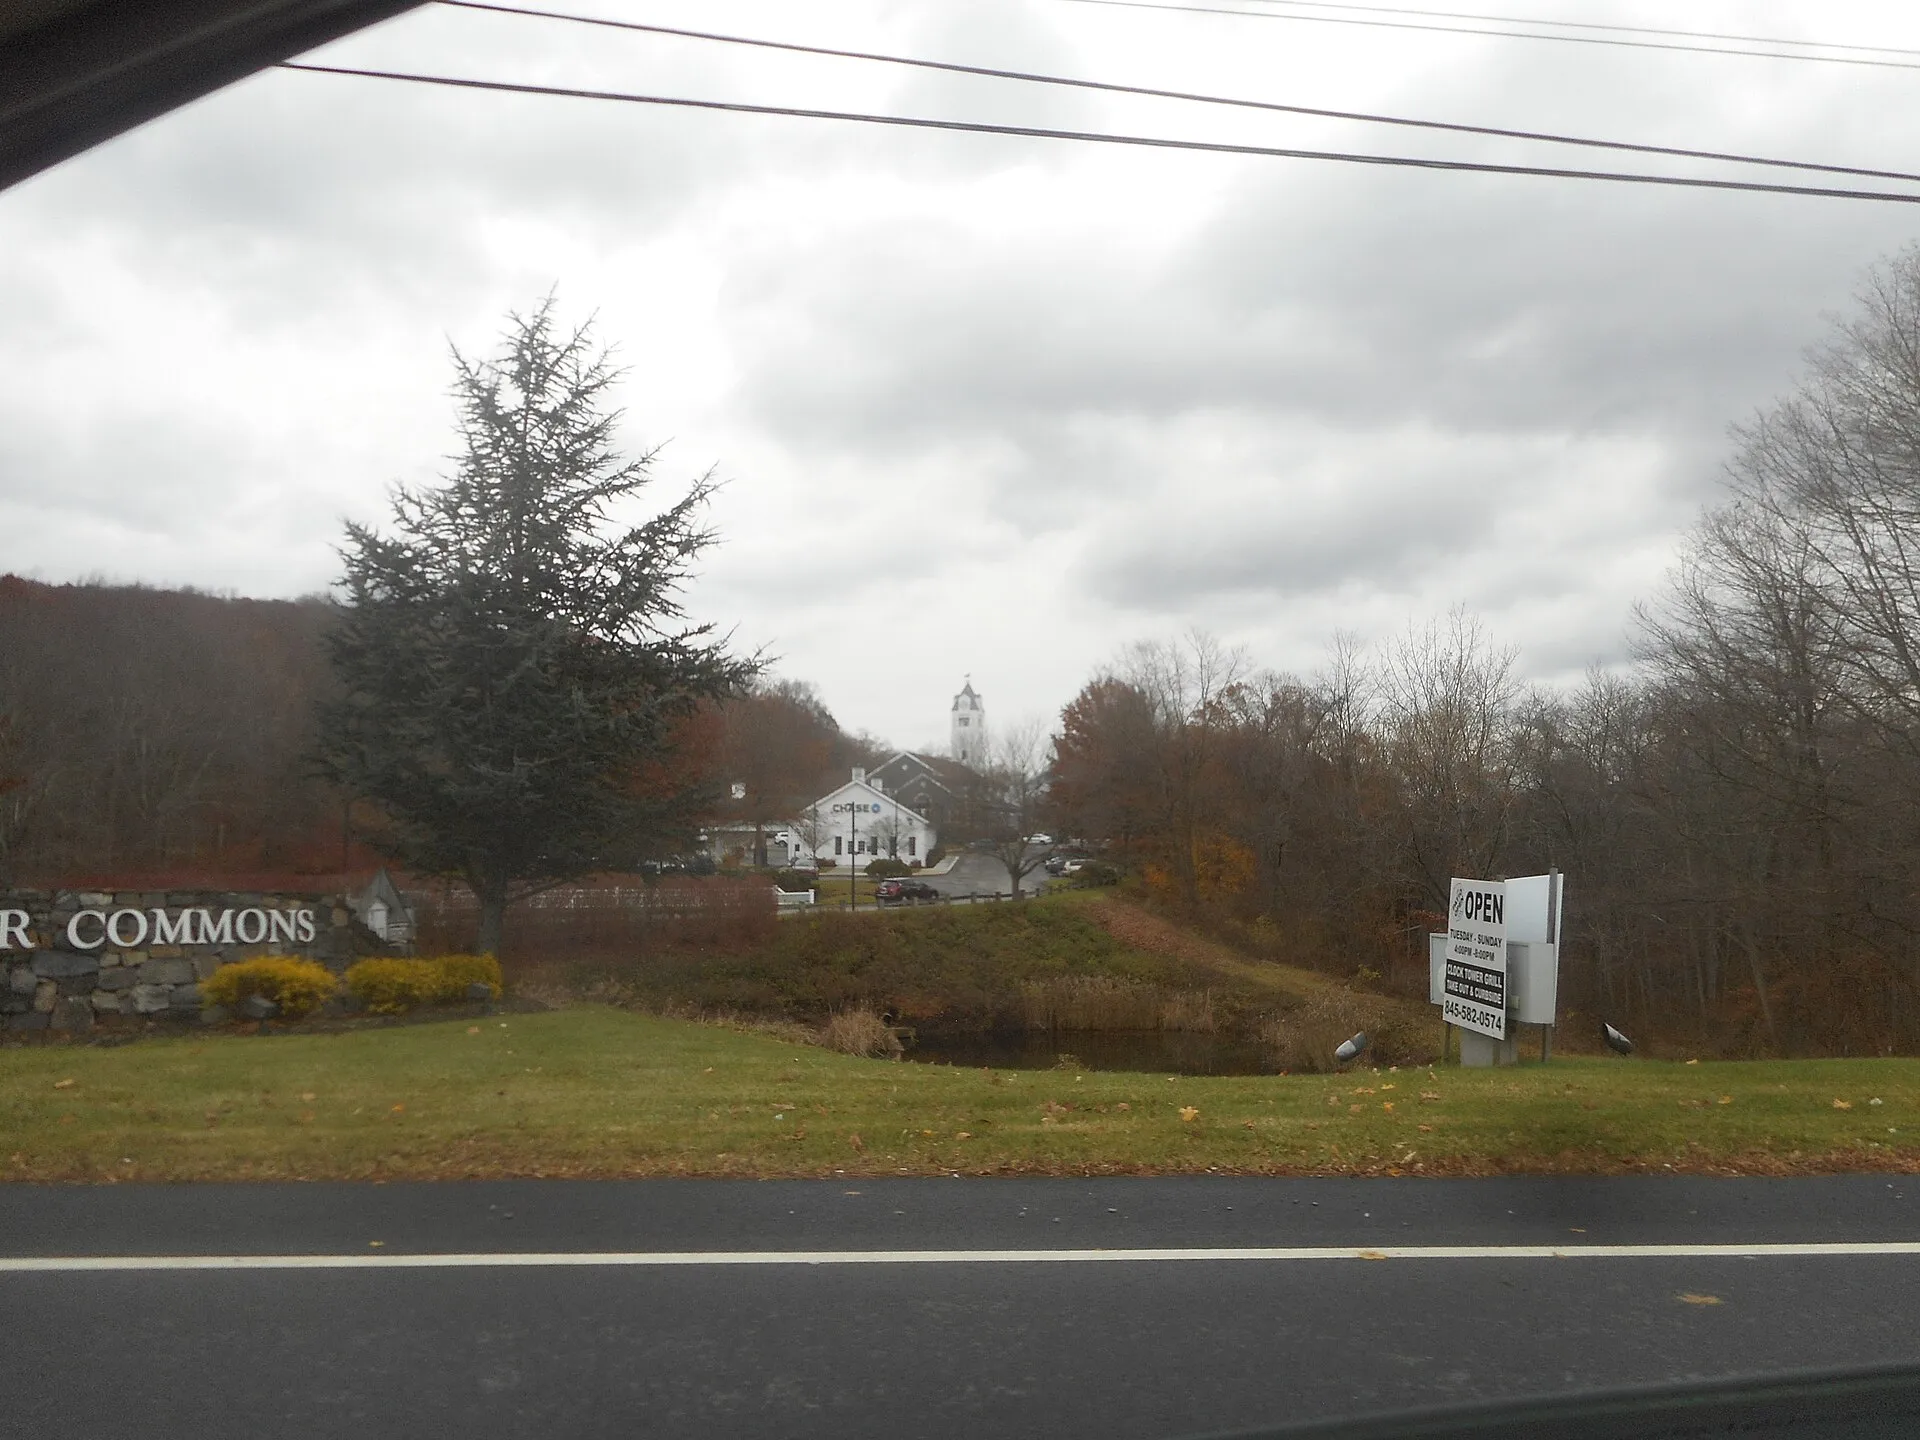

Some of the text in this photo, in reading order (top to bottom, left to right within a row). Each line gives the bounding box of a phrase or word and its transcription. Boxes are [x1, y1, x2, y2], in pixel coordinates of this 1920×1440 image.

[1465, 891, 1504, 925] OPEN
[67, 908, 316, 950] COMMONS
[1450, 928, 1474, 943] TUESDAY
[1478, 933, 1503, 949] SUNDAY
[1447, 963, 1503, 989] CLOCK TOWER GRILL
[1446, 979, 1502, 1005] TAKE OUT & CURBSIDE
[1445, 999, 1502, 1032] 845-582-0574
